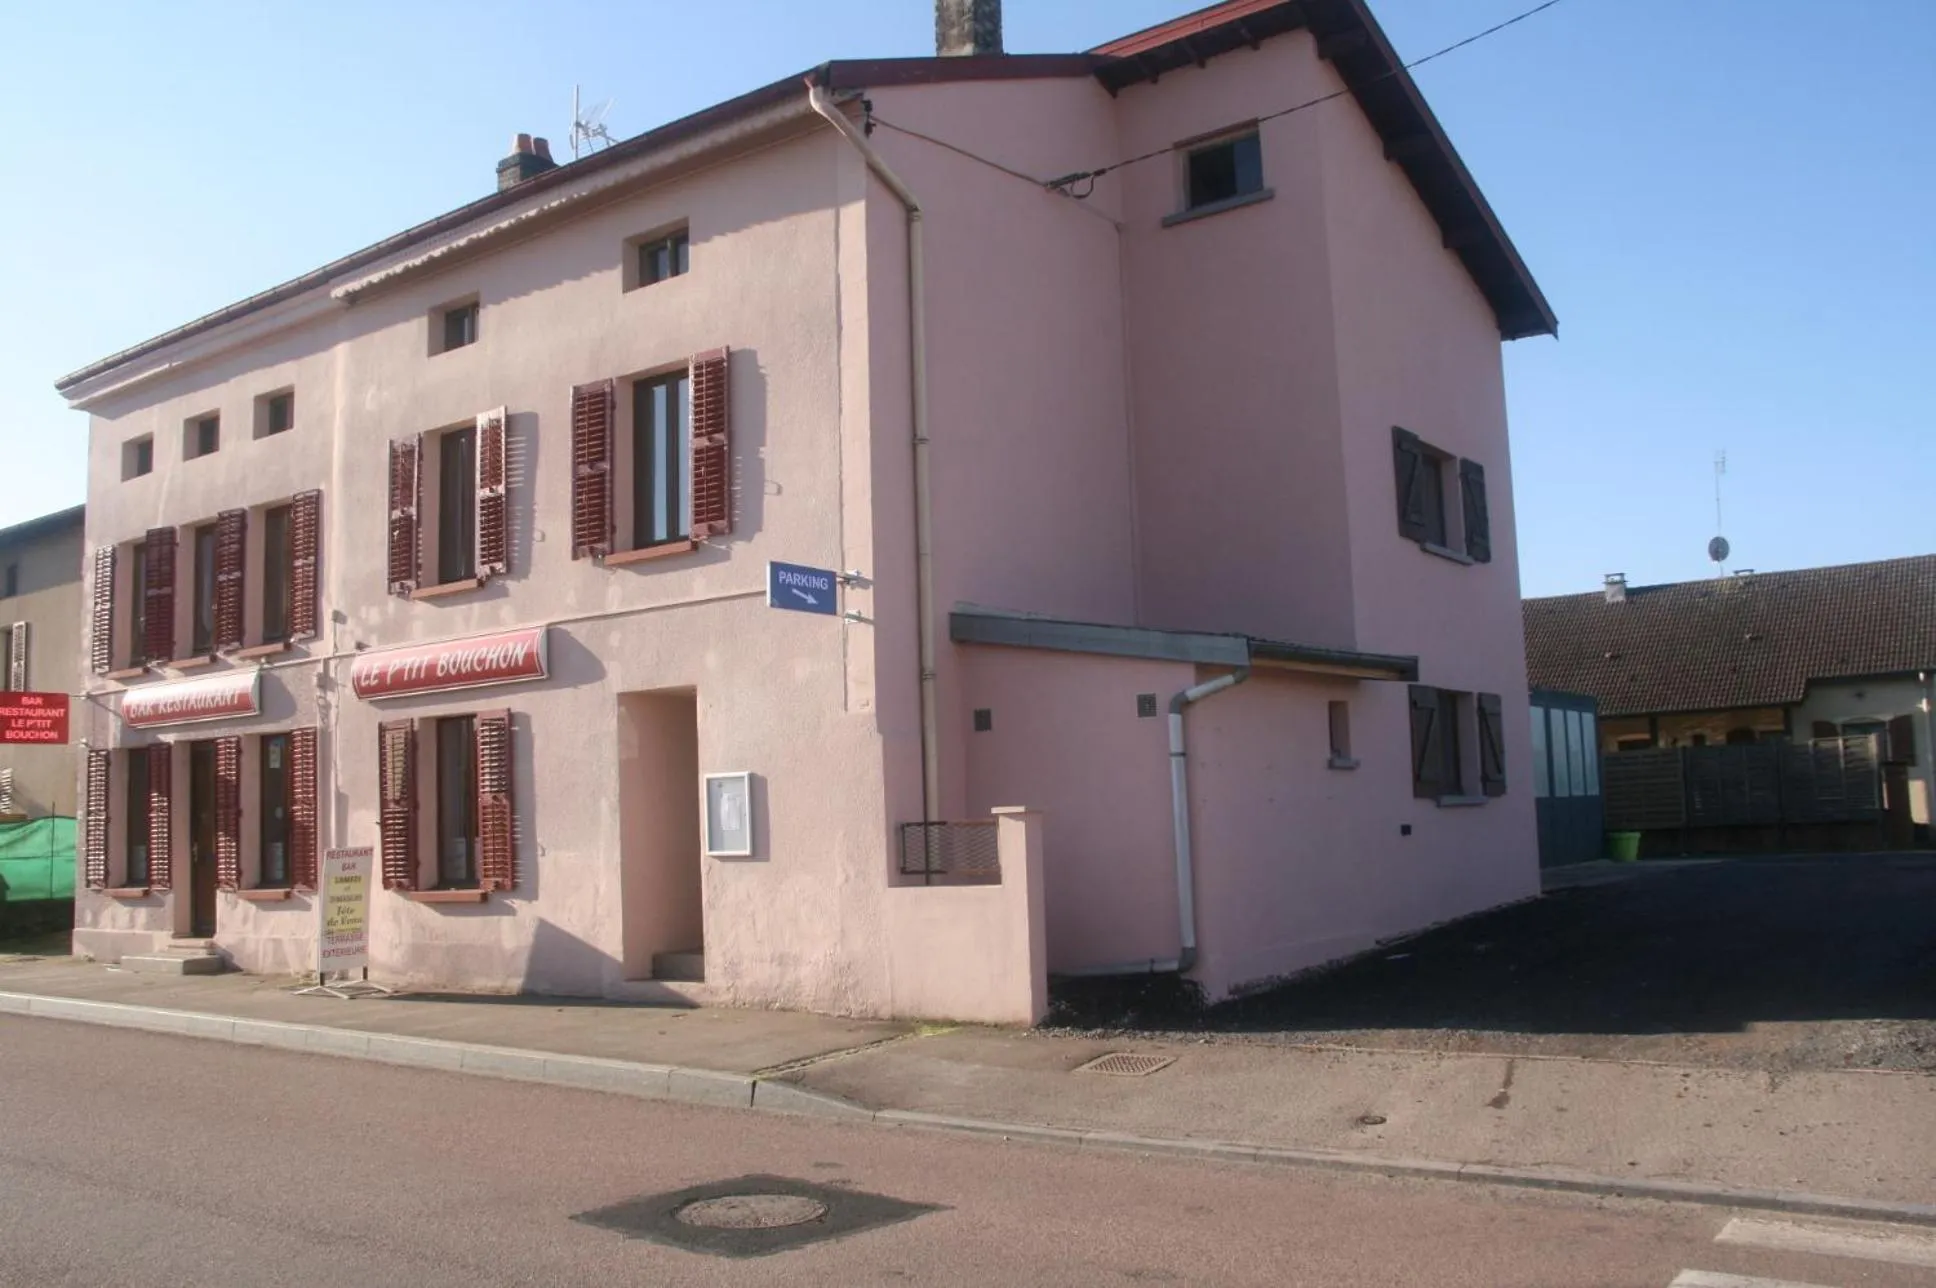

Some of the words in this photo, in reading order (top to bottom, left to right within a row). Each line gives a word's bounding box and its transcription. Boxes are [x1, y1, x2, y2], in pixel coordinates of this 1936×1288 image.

[778, 571, 829, 590] PARKING
[360, 663, 378, 687] LE
[436, 640, 530, 677] BOUCHON
[21, 696, 43, 706] BAR
[158, 688, 239, 714] RESTAURANT
[0, 707, 66, 717] RESTAURANT
[11, 719, 25, 728] LE
[5, 730, 58, 739] BOUCHON
[326, 848, 373, 860] RESTAURANT
[341, 862, 357, 871] BAR
